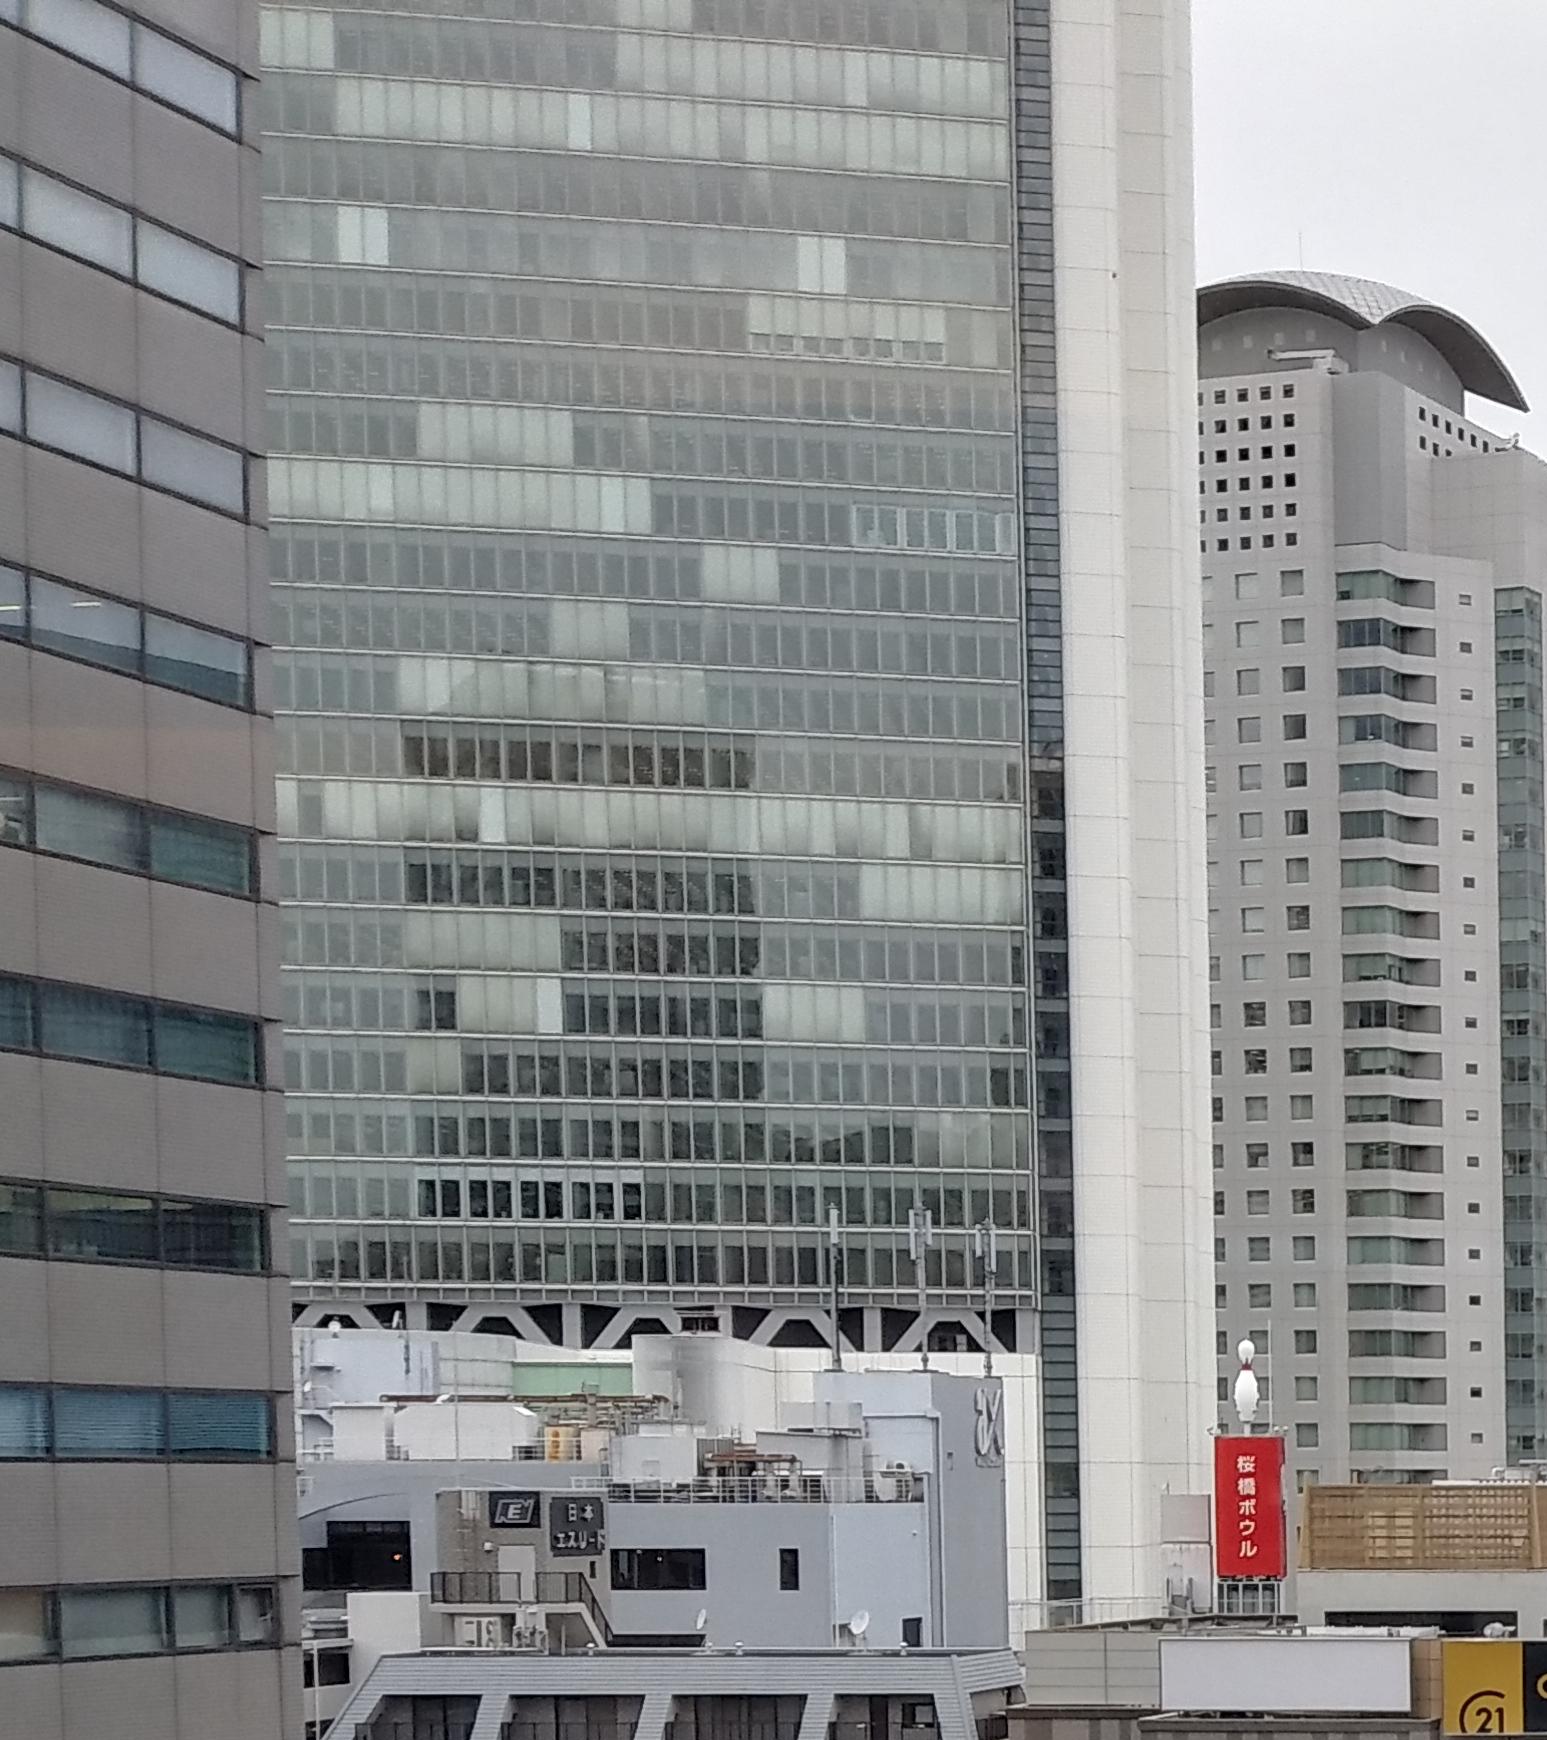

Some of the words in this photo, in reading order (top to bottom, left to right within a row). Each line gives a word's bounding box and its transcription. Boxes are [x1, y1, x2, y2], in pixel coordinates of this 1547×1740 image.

[567, 1502, 594, 1522] 日本
[1236, 1455, 1258, 1558] 桜橋ボウル
[556, 1529, 606, 1550] エスリード
